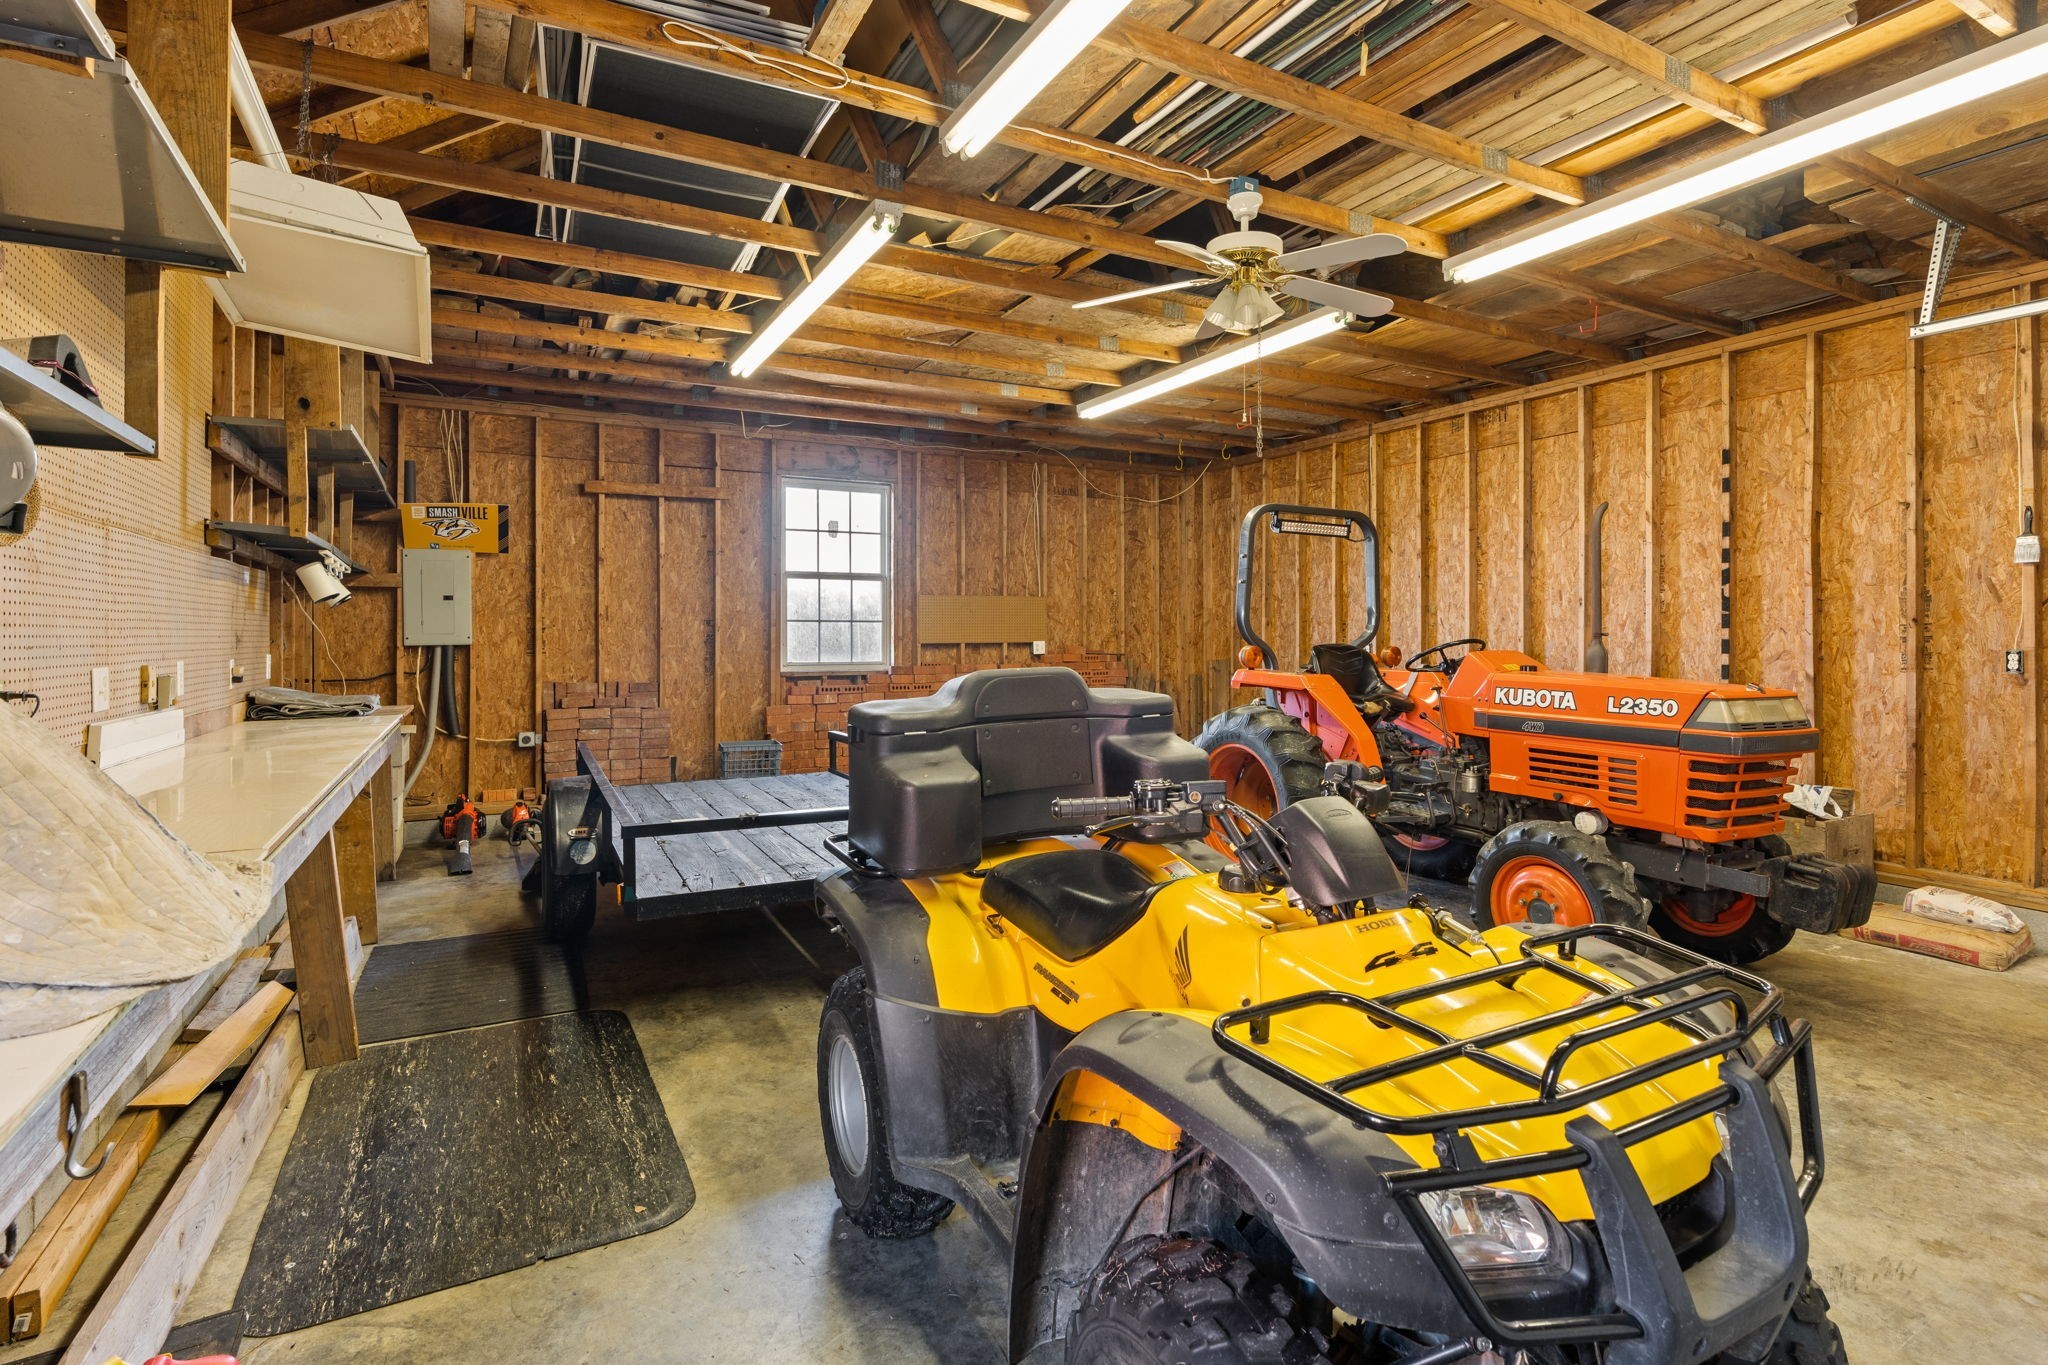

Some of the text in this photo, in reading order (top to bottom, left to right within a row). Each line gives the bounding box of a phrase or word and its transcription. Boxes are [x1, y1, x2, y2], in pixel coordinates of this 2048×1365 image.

[1494, 687, 1679, 717] KUBOTA L2350
[1522, 721, 1544, 732] 4WD
